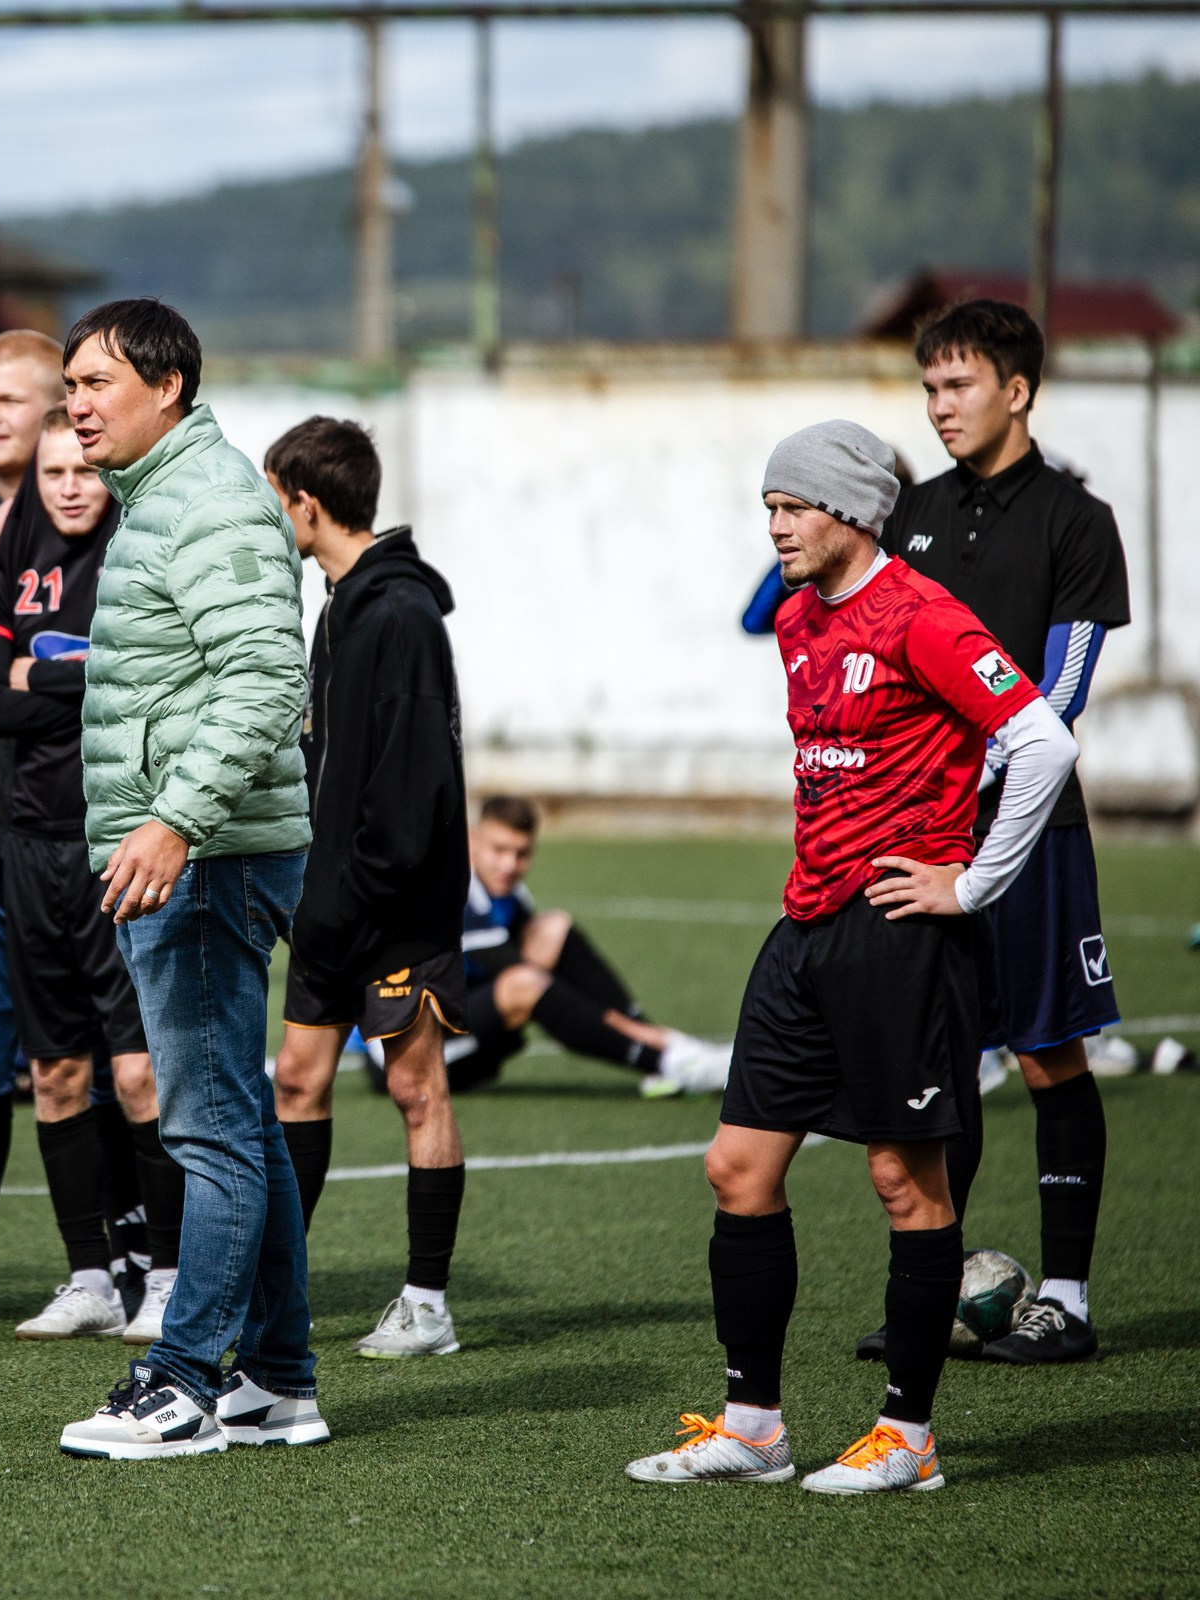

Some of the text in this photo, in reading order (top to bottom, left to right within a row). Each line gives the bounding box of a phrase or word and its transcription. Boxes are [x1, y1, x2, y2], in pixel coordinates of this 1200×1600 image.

[14, 566, 63, 615] 21
[842, 653, 875, 694] 10
[155, 1409, 178, 1424] USPA
